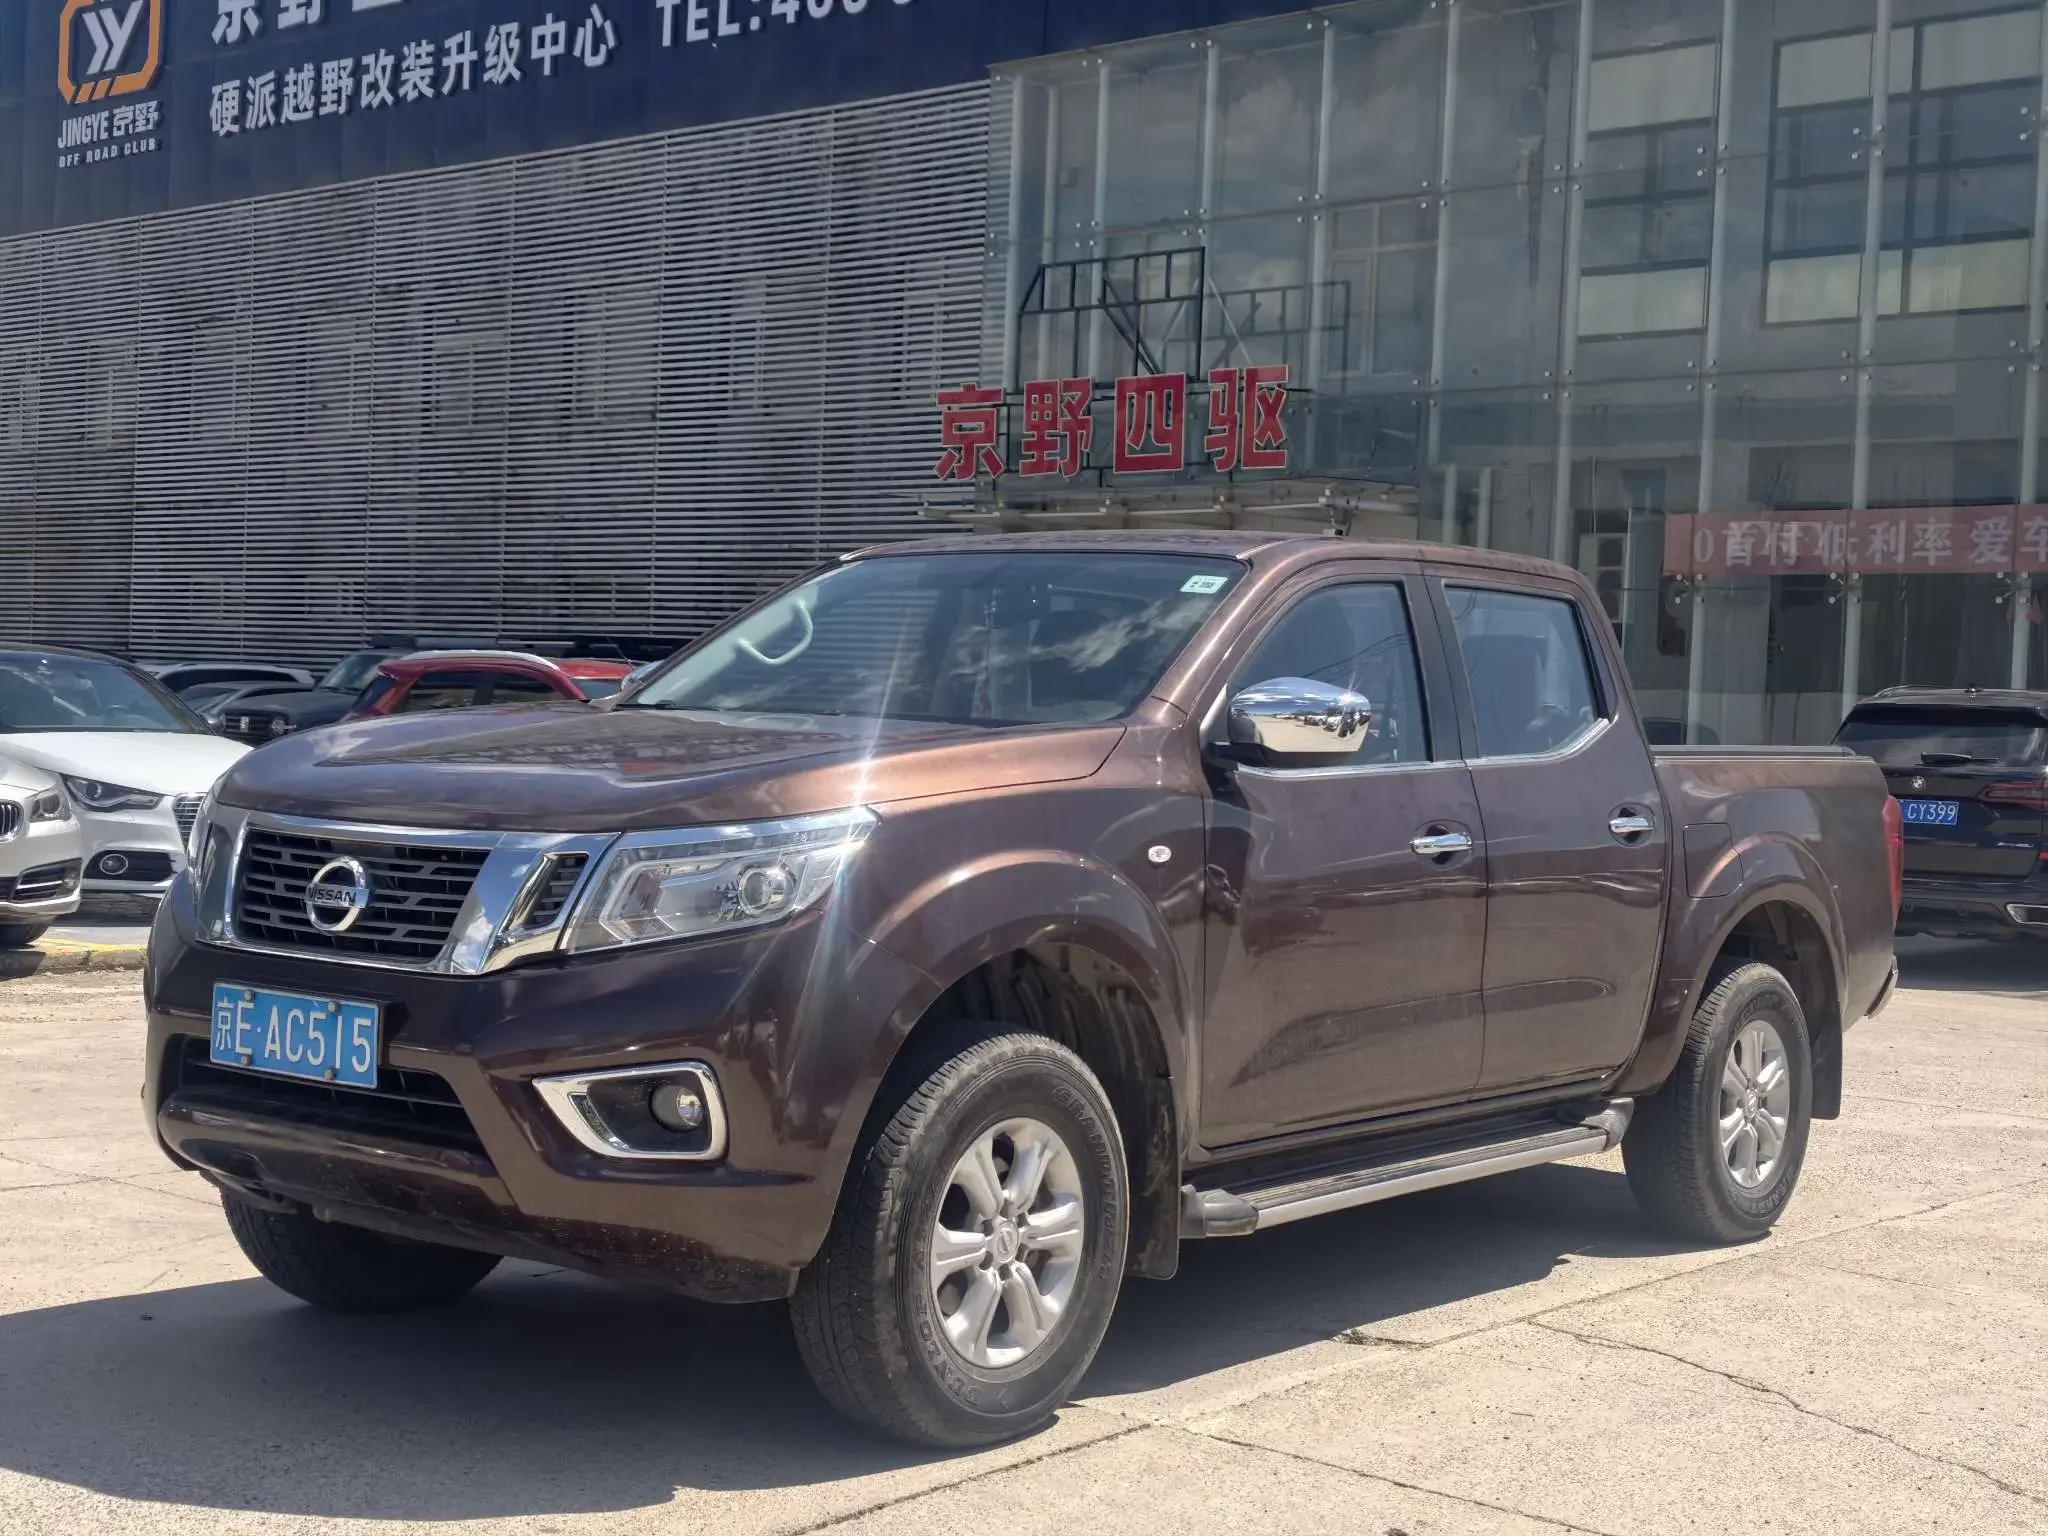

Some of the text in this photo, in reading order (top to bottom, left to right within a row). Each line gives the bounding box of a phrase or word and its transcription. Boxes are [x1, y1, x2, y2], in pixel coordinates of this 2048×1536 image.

[656, 0, 868, 47] TEL:
[210, 3, 615, 137] 硬派越野改装升级中心
[58, 110, 110, 149] JINGYE
[59, 137, 157, 169] OFF ROAD CLUB
[934, 365, 1289, 480] 京野四驱
[1907, 803, 1957, 824] CY399
[308, 887, 357, 904] NISSAN
